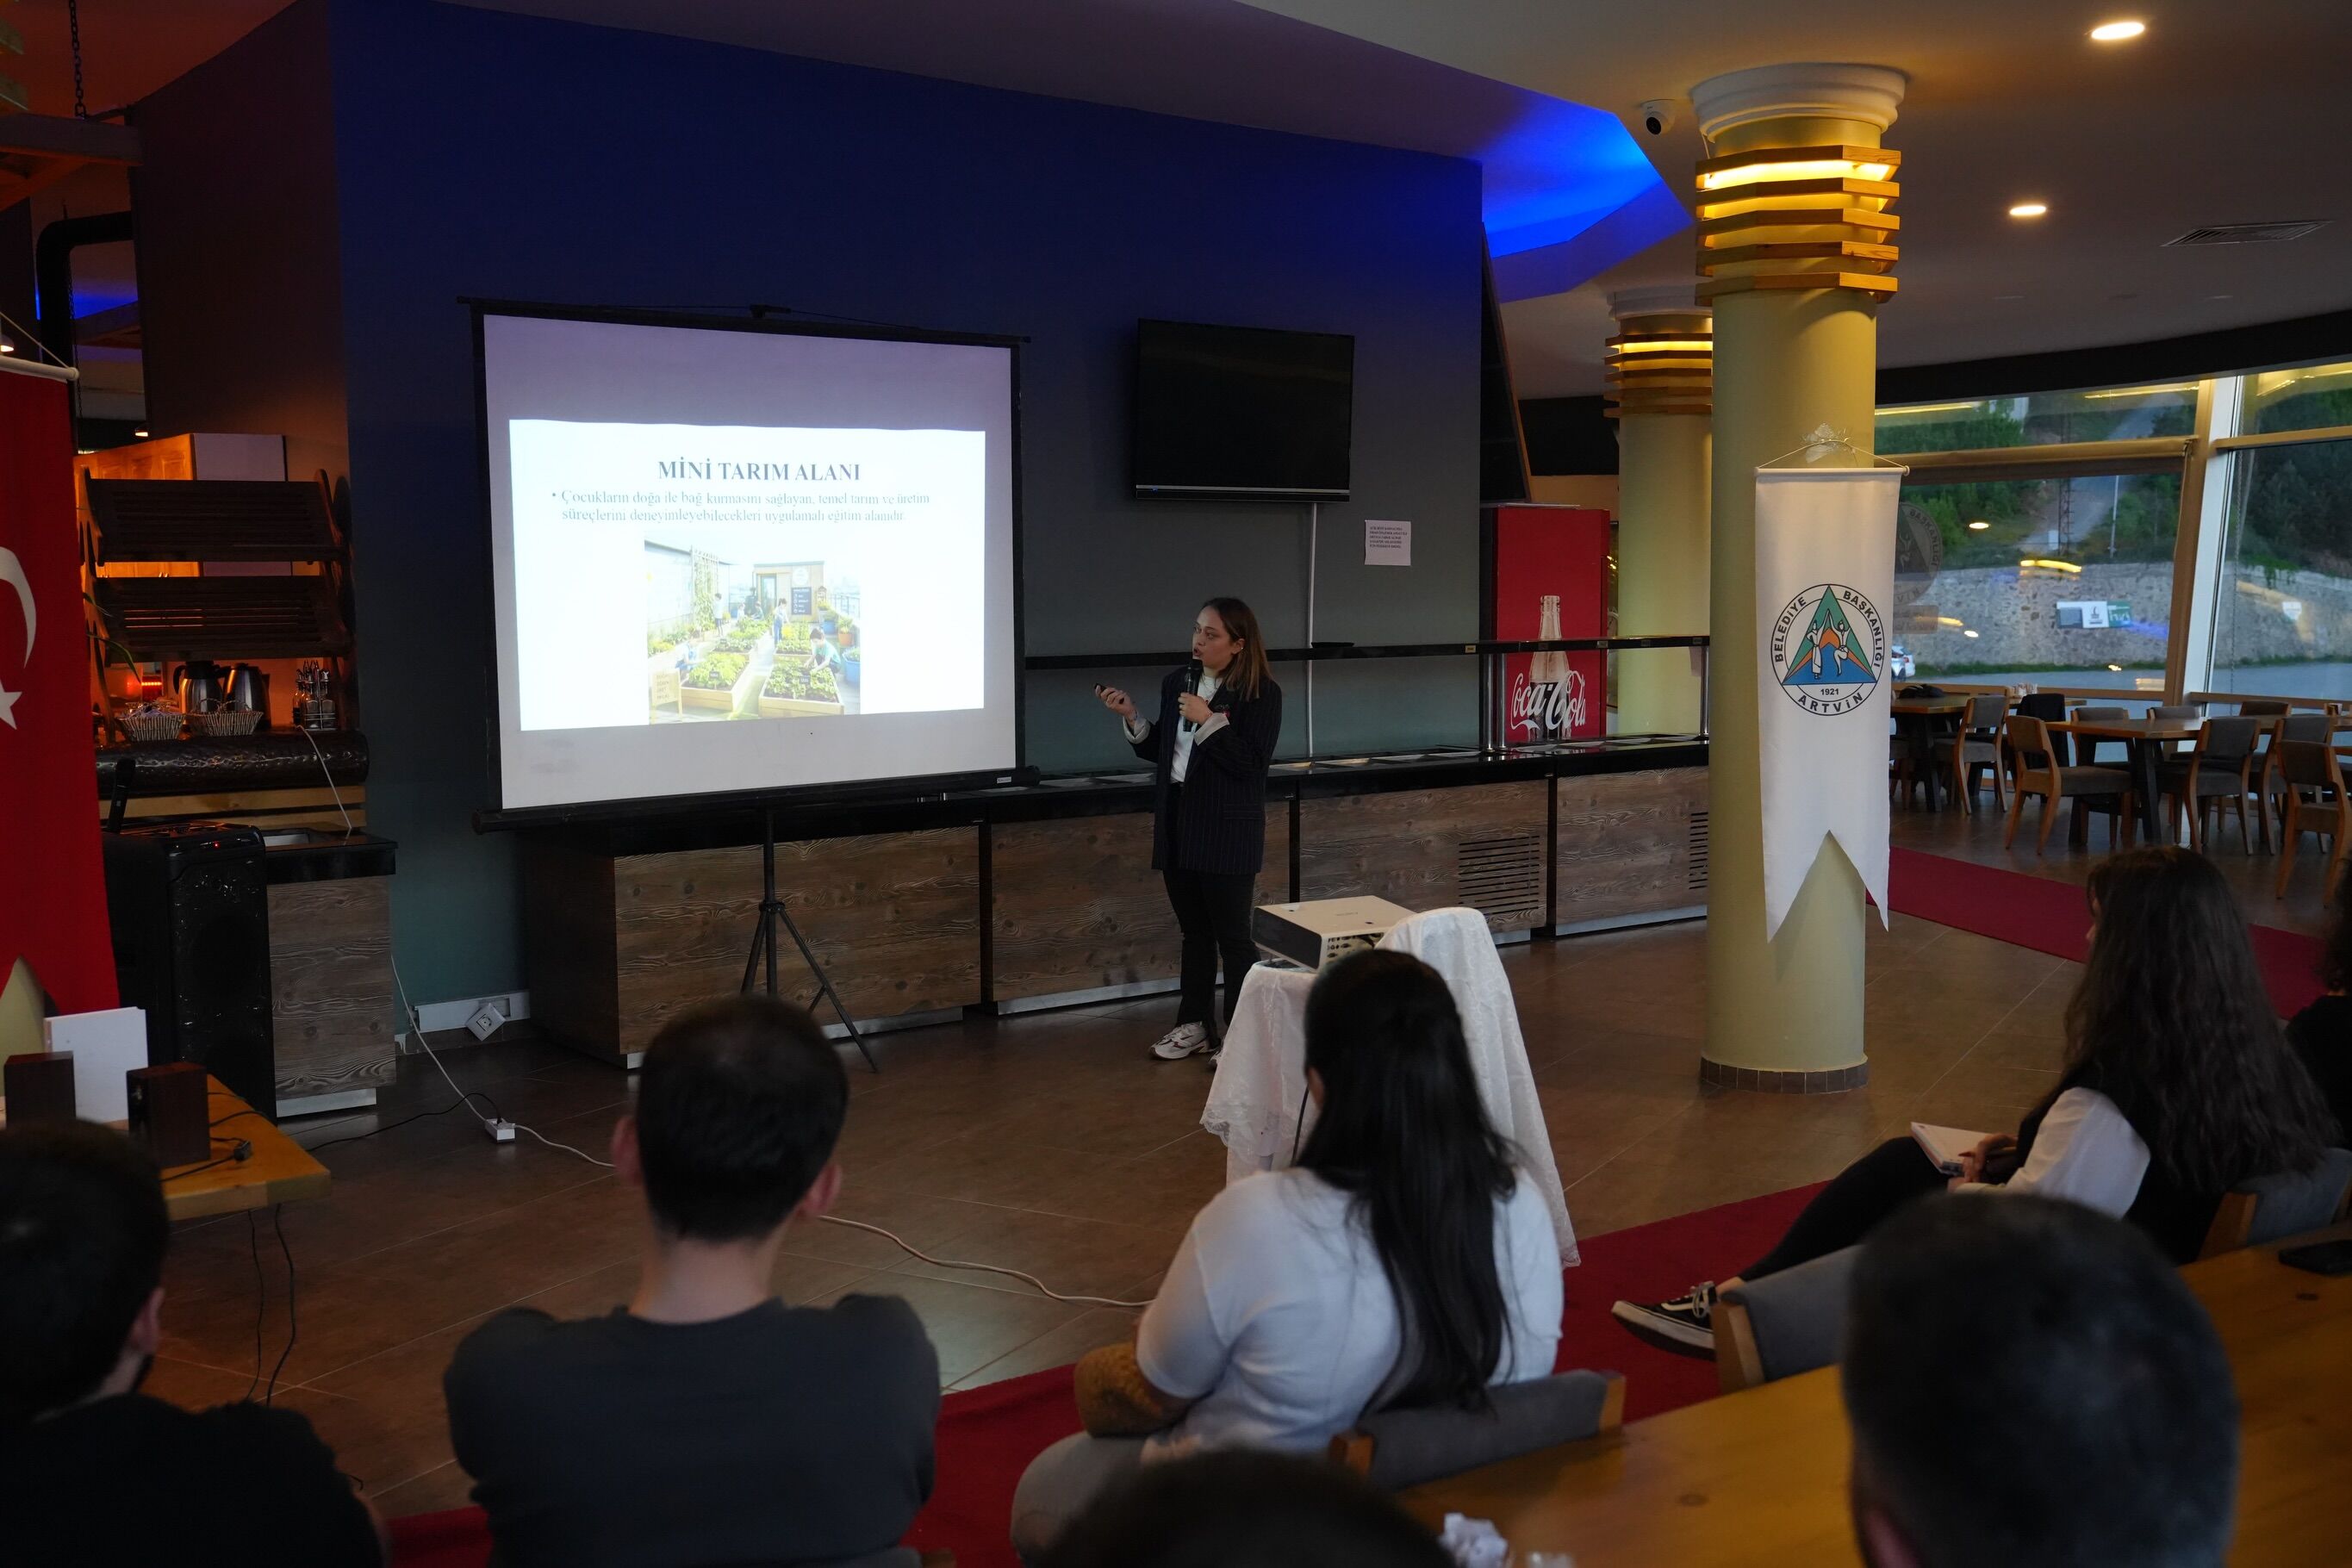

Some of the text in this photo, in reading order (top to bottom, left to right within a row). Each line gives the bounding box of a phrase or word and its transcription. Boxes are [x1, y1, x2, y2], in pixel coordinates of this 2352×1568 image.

[658, 456, 861, 481] MİNİ TARIM ALANI
[561, 489, 629, 504] Çocukların
[632, 492, 661, 506] doğa
[664, 491, 678, 503] ile
[681, 491, 702, 506] bağ
[706, 493, 762, 504] kurmasını
[818, 492, 848, 504] temel
[851, 494, 880, 504] tarım
[882, 496, 895, 505] ve
[897, 493, 930, 504] üretim
[562, 508, 627, 523] süreçlerini
[630, 508, 762, 523] deneyimleyebilecekleri
[764, 510, 825, 524] uygulamalı
[827, 510, 862, 522] eğitim
[1843, 590, 1884, 668] BAŞKANLIĞI
[1510, 669, 1586, 731] Coca-Cola
